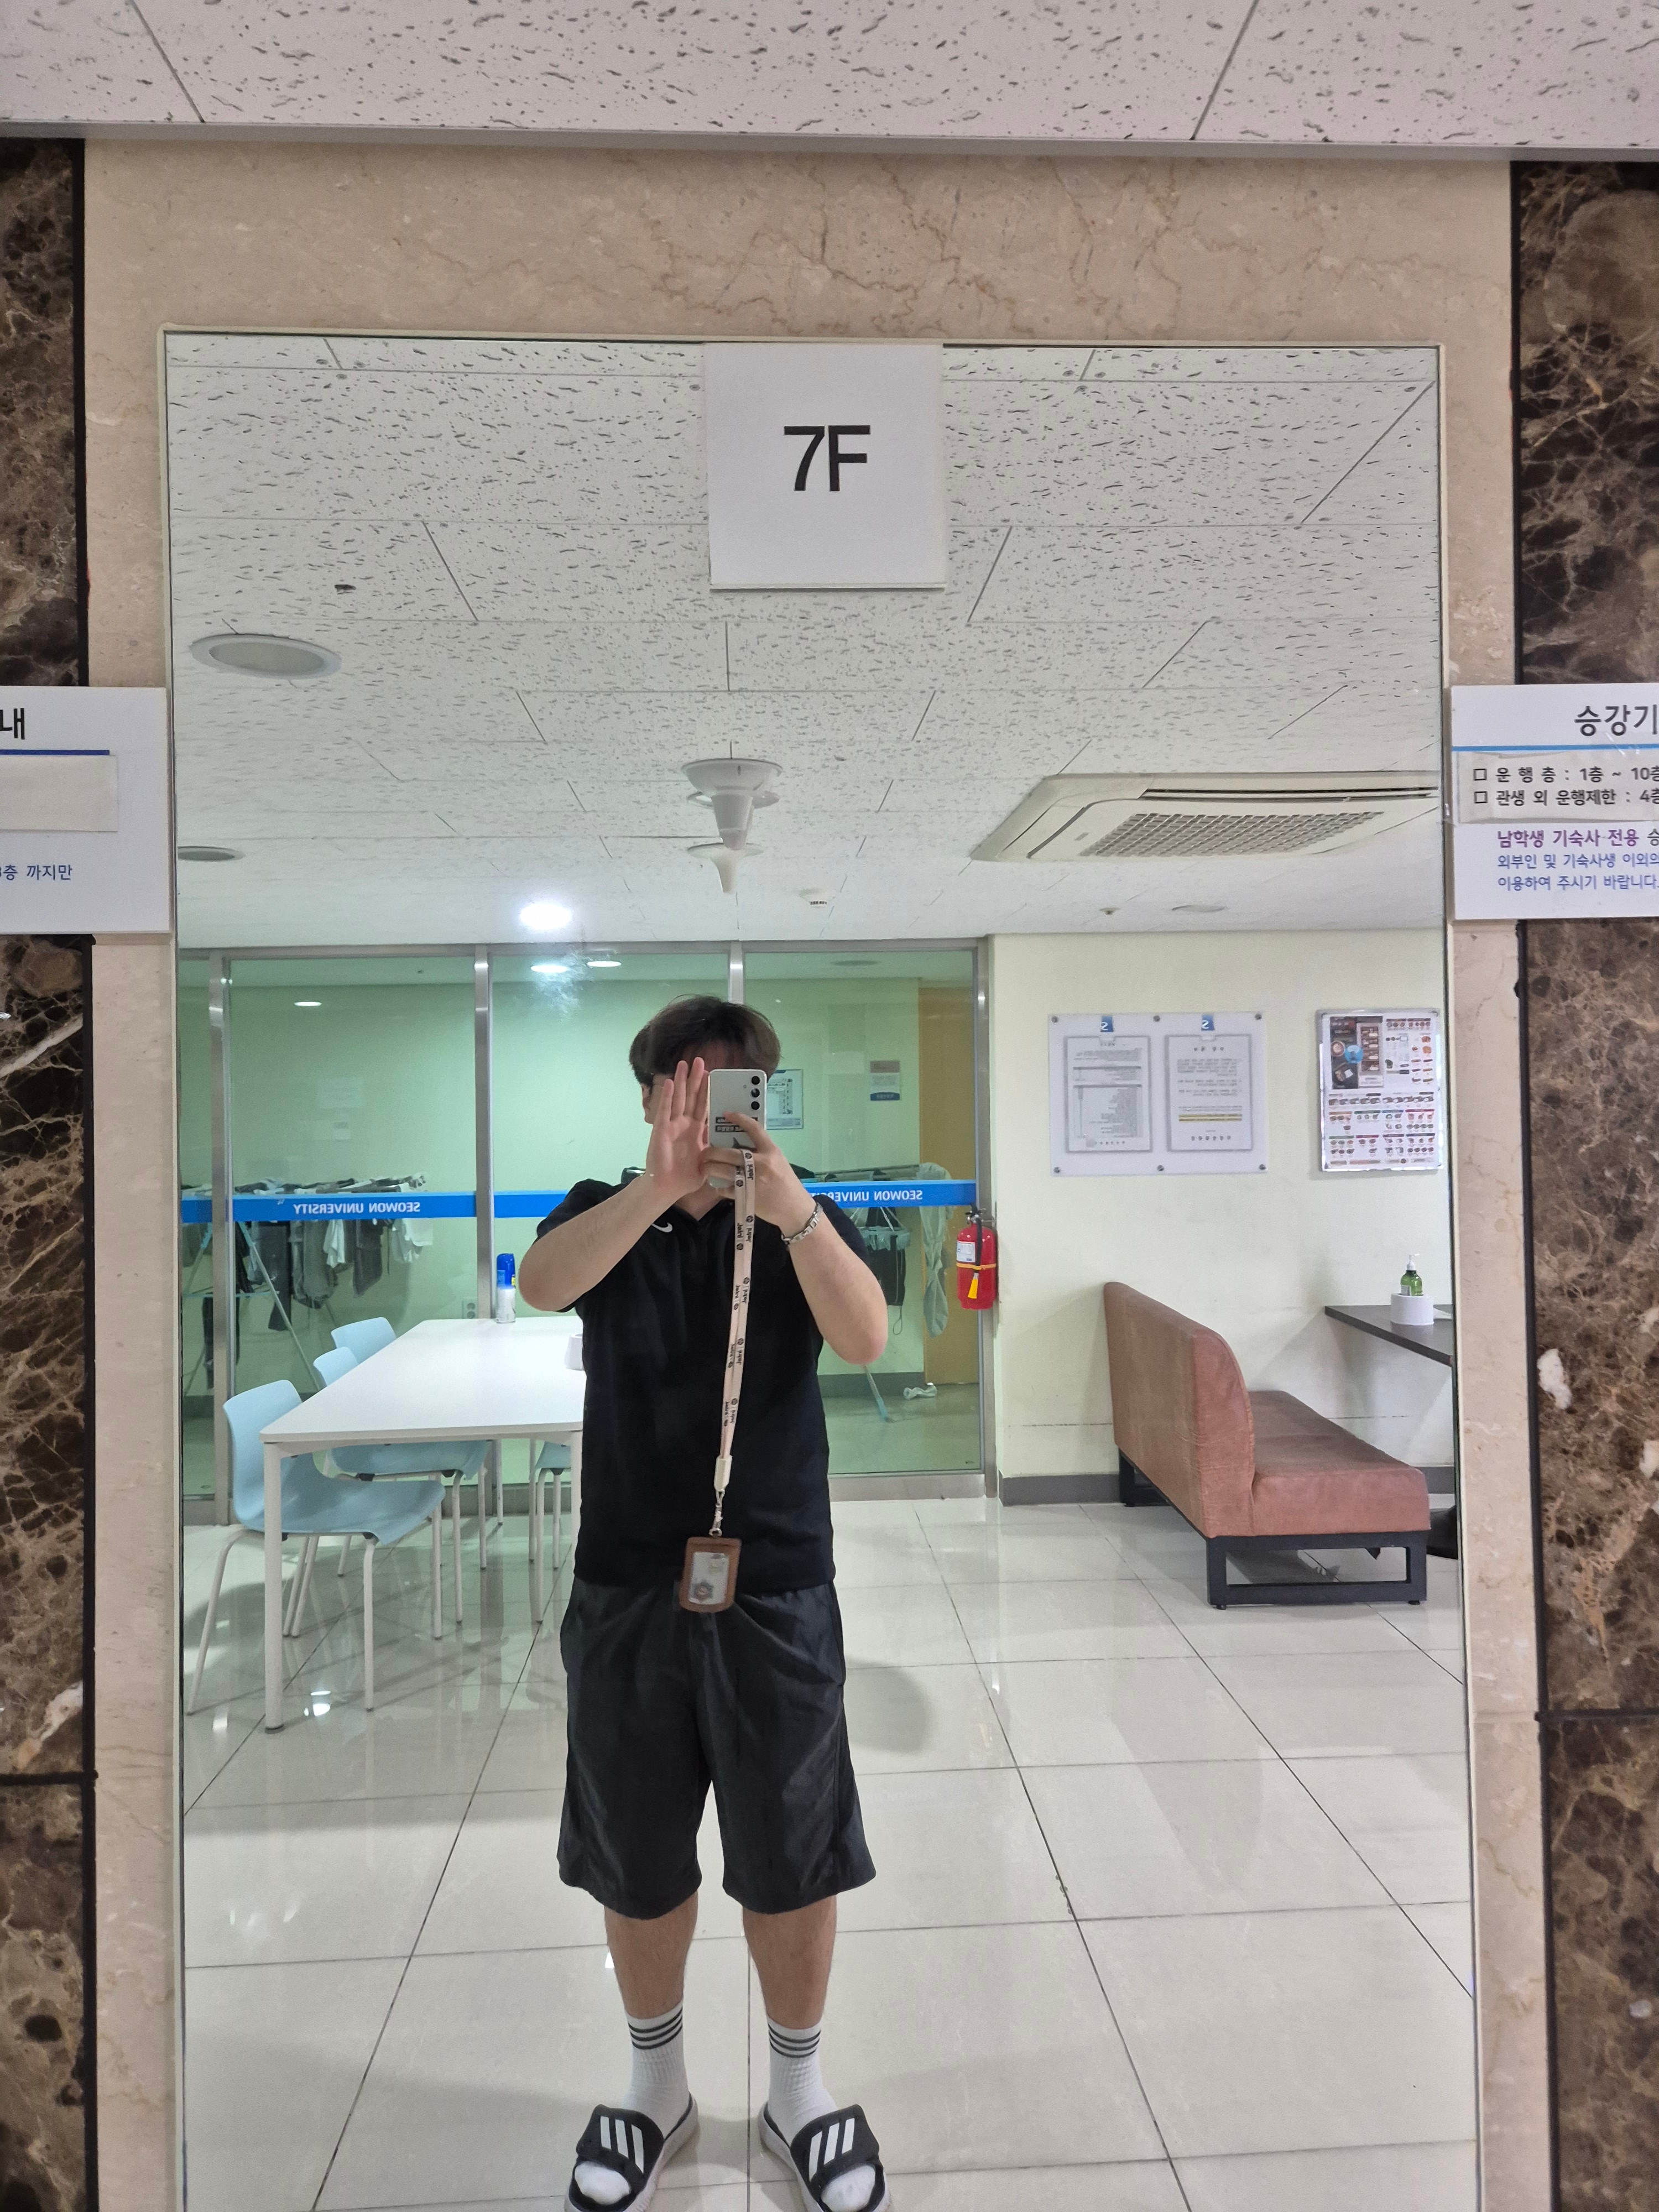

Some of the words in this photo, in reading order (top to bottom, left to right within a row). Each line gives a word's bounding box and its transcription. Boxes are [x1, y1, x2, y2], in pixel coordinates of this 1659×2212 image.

[784, 425, 871, 492] 7F
[1574, 704, 1658, 737] 승강기
[1496, 767, 1511, 783] 운
[1518, 766, 1533, 784] 행
[1541, 766, 1556, 783] 층
[1579, 766, 1604, 783] 1층
[1496, 789, 1525, 807] 관생
[1533, 790, 1548, 806] 외
[1555, 789, 1616, 806] 운행제한
[1497, 829, 1545, 849] 남학생
[1552, 830, 1600, 847] 기숙사
[1608, 828, 1640, 847] 전용
[1497, 854, 1537, 869] 외부인
[1543, 853, 1557, 869] 및
[1563, 853, 1616, 869] 기숙사생
[27, 863, 73, 881] 까지만
[1497, 875, 1551, 892] 이용하여
[1557, 875, 1597, 891] 주시기
